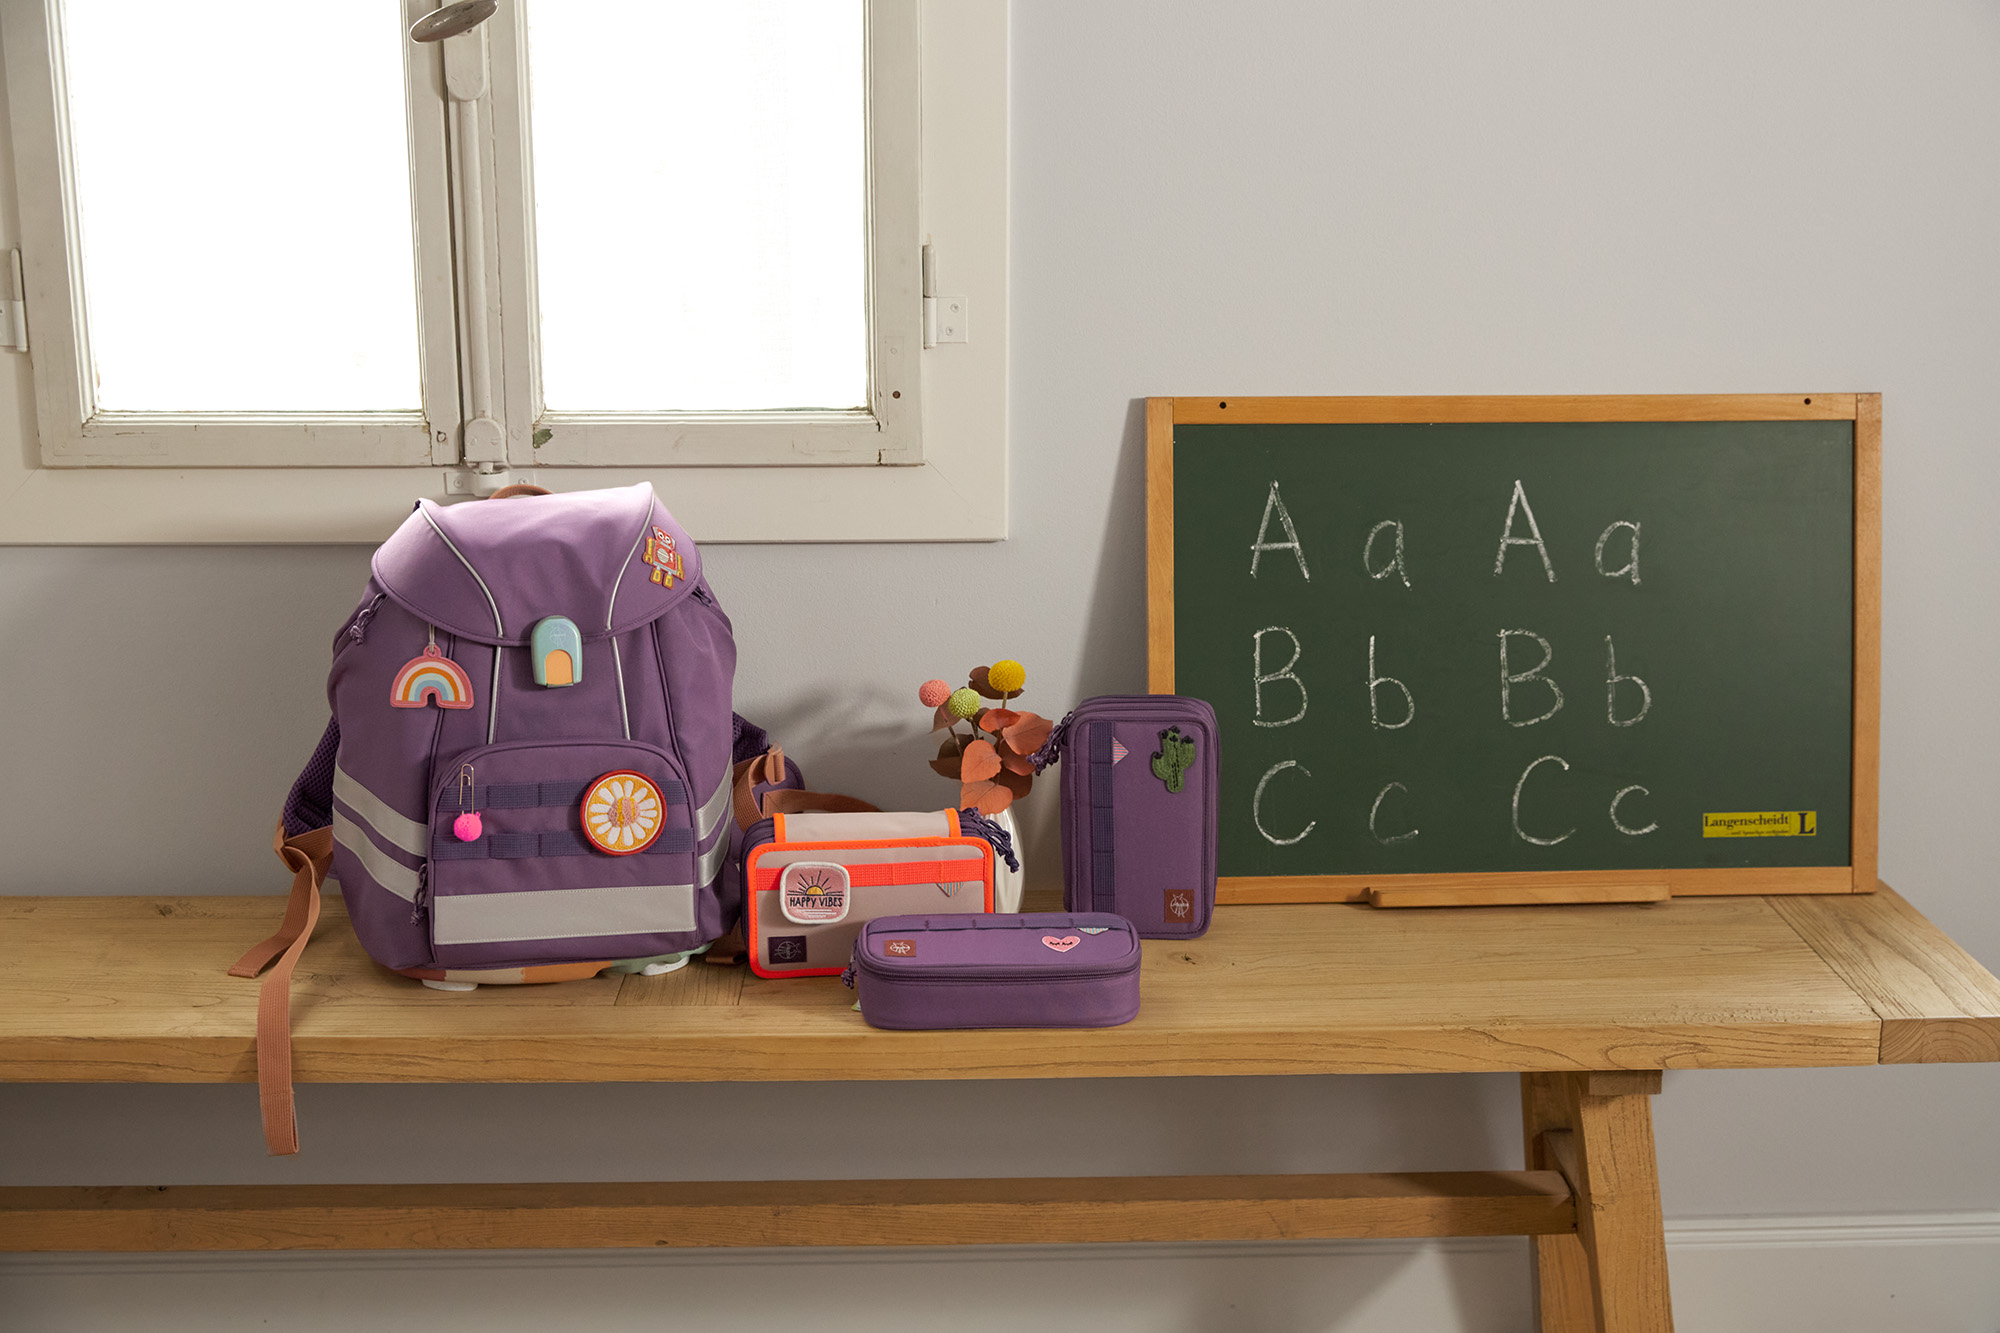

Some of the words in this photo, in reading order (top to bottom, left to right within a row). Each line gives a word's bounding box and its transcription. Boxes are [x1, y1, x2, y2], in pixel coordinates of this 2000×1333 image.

[1249, 479, 1310, 583] A
[1363, 519, 1413, 591] a
[1493, 479, 1558, 583] A
[1594, 520, 1642, 586] a
[1252, 625, 1309, 728] B
[1364, 634, 1415, 730] b
[1496, 628, 1564, 728] B
[1604, 634, 1652, 728] b
[1252, 759, 1317, 846] C
[1369, 782, 1419, 845] c
[1511, 755, 1577, 846] C
[1608, 784, 1658, 836] c
[1704, 813, 1788, 830] Langenscheidt
[1798, 812, 1815, 835] L
[789, 896, 817, 908] HAPPY
[819, 896, 843, 908] VIBES
